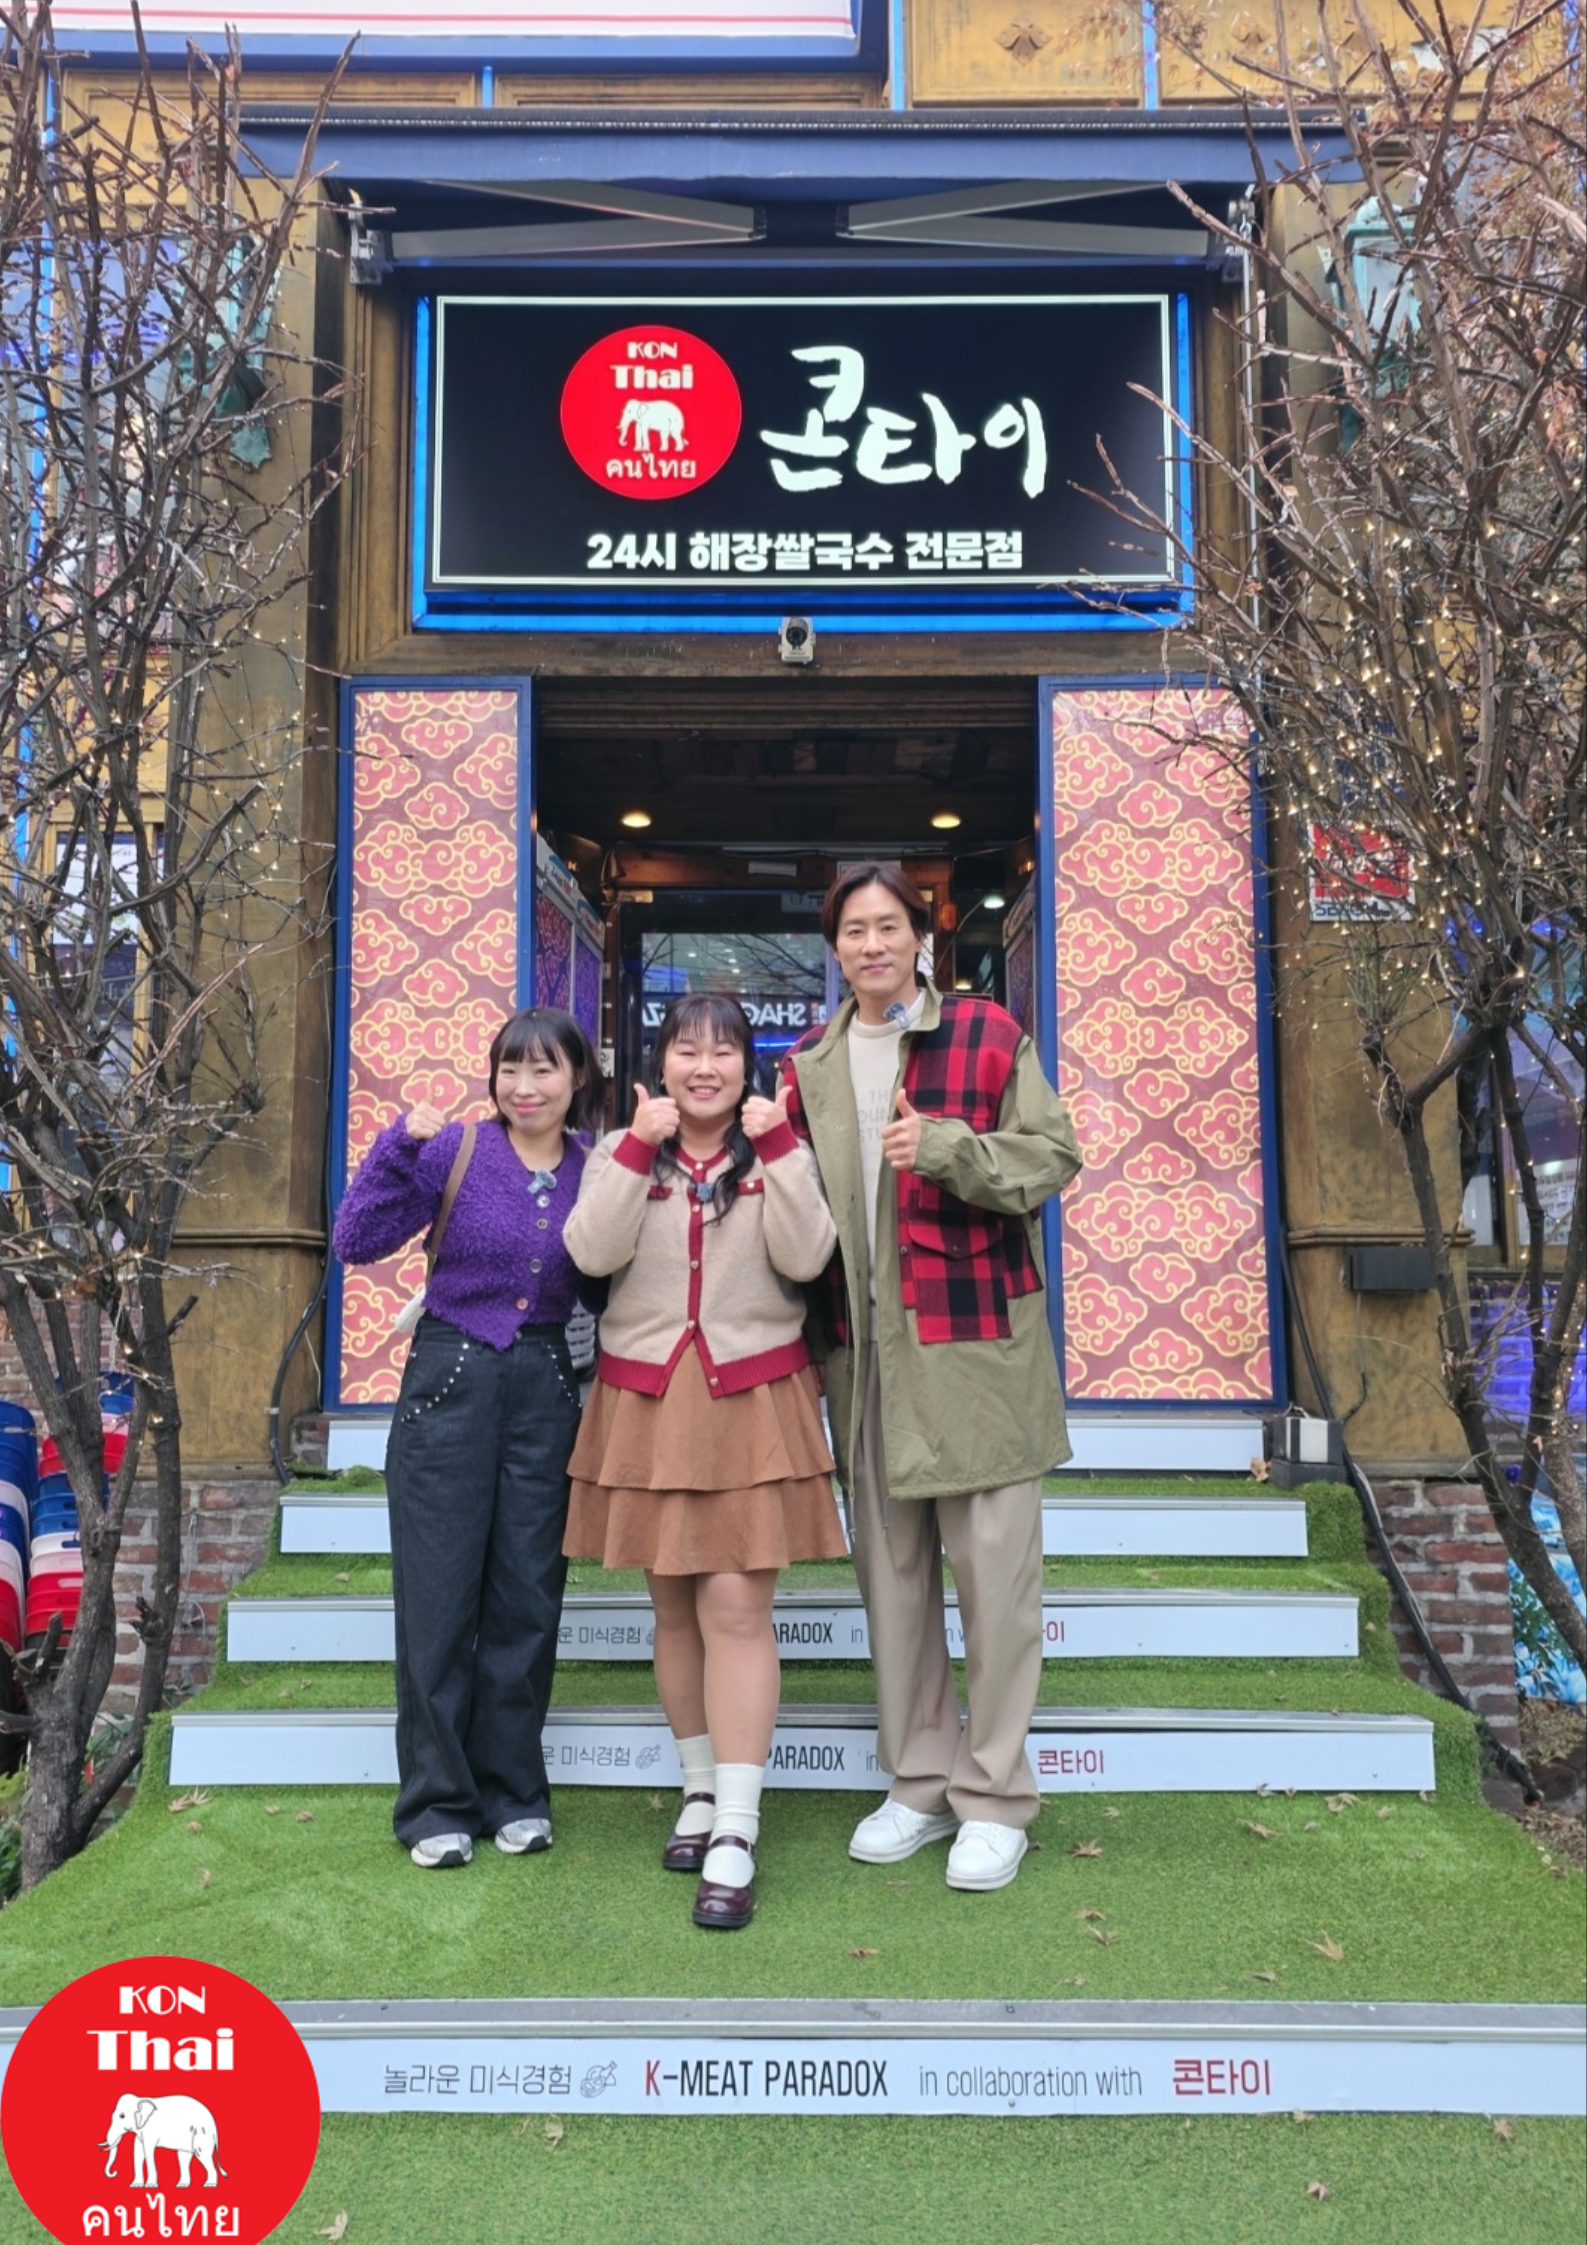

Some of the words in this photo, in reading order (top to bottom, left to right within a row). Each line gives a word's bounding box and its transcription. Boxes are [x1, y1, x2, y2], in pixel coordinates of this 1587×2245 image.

[627, 341, 678, 360] KON
[610, 364, 694, 389] Thai
[760, 345, 1047, 499] 콘타이
[606, 452, 697, 479] คนไทย
[587, 533, 677, 570] 24시
[689, 531, 894, 572] 해장쌀국수
[905, 530, 1023, 570] 전문점
[579, 1626, 641, 1644] 미식경험
[851, 1625, 863, 1644] in
[562, 1745, 630, 1767] 미식경험
[1038, 1749, 1104, 1774] 콘타이
[384, 2064, 460, 2094] 놀라운
[470, 2064, 571, 2094] 미식경험
[646, 2060, 753, 2096] K-MEAT
[765, 2060, 888, 2097] PARADOX
[919, 2066, 938, 2096] in
[946, 2066, 1087, 2097] collaboration
[1095, 2066, 1142, 2096] with
[1173, 2059, 1271, 2096] 콘타이
